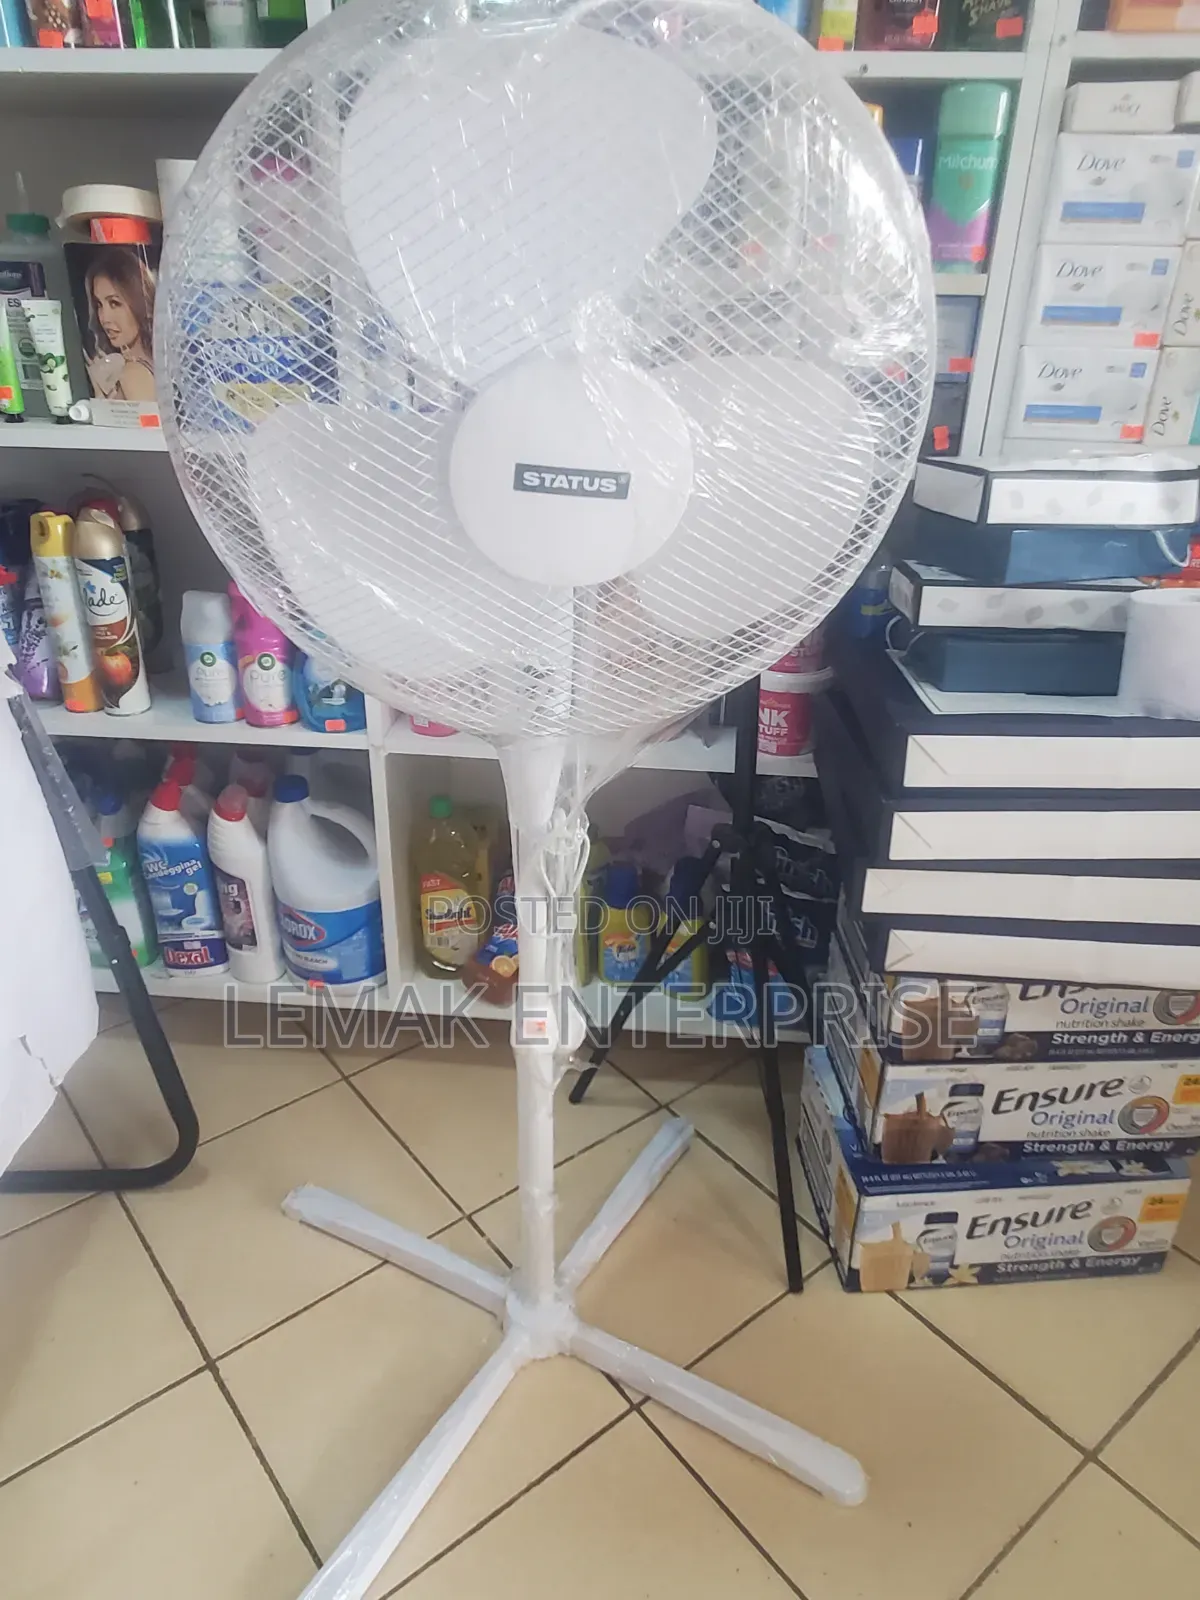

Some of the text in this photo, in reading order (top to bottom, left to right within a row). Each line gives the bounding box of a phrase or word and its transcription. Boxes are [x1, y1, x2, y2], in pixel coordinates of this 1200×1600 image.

[1076, 153, 1127, 171] Dove
[1056, 260, 1103, 279] Dove
[1172, 293, 1194, 336] Dove
[1037, 362, 1083, 379] Dove
[1152, 396, 1173, 436] Dove
[523, 471, 617, 493] STATUS
[82, 588, 124, 607] lade
[758, 707, 791, 728] NK
[758, 724, 789, 737] TUFF
[146, 861, 168, 873] WC
[185, 860, 203, 877] gel
[1060, 996, 1149, 1019] Original
[1055, 1018, 1146, 1029] nutrition shake
[1051, 1032, 1200, 1047] Strength & Energ
[991, 1077, 1126, 1115] Ensure
[1031, 1109, 1116, 1129] Original
[1026, 1128, 1111, 1139] nutrition shake
[1022, 1139, 1175, 1155] Strength & Energy
[966, 1199, 1093, 1240] Ensure
[1003, 1230, 1085, 1251] Original
[997, 1259, 1066, 1275] Strength
[1085, 1255, 1142, 1269] Energy
